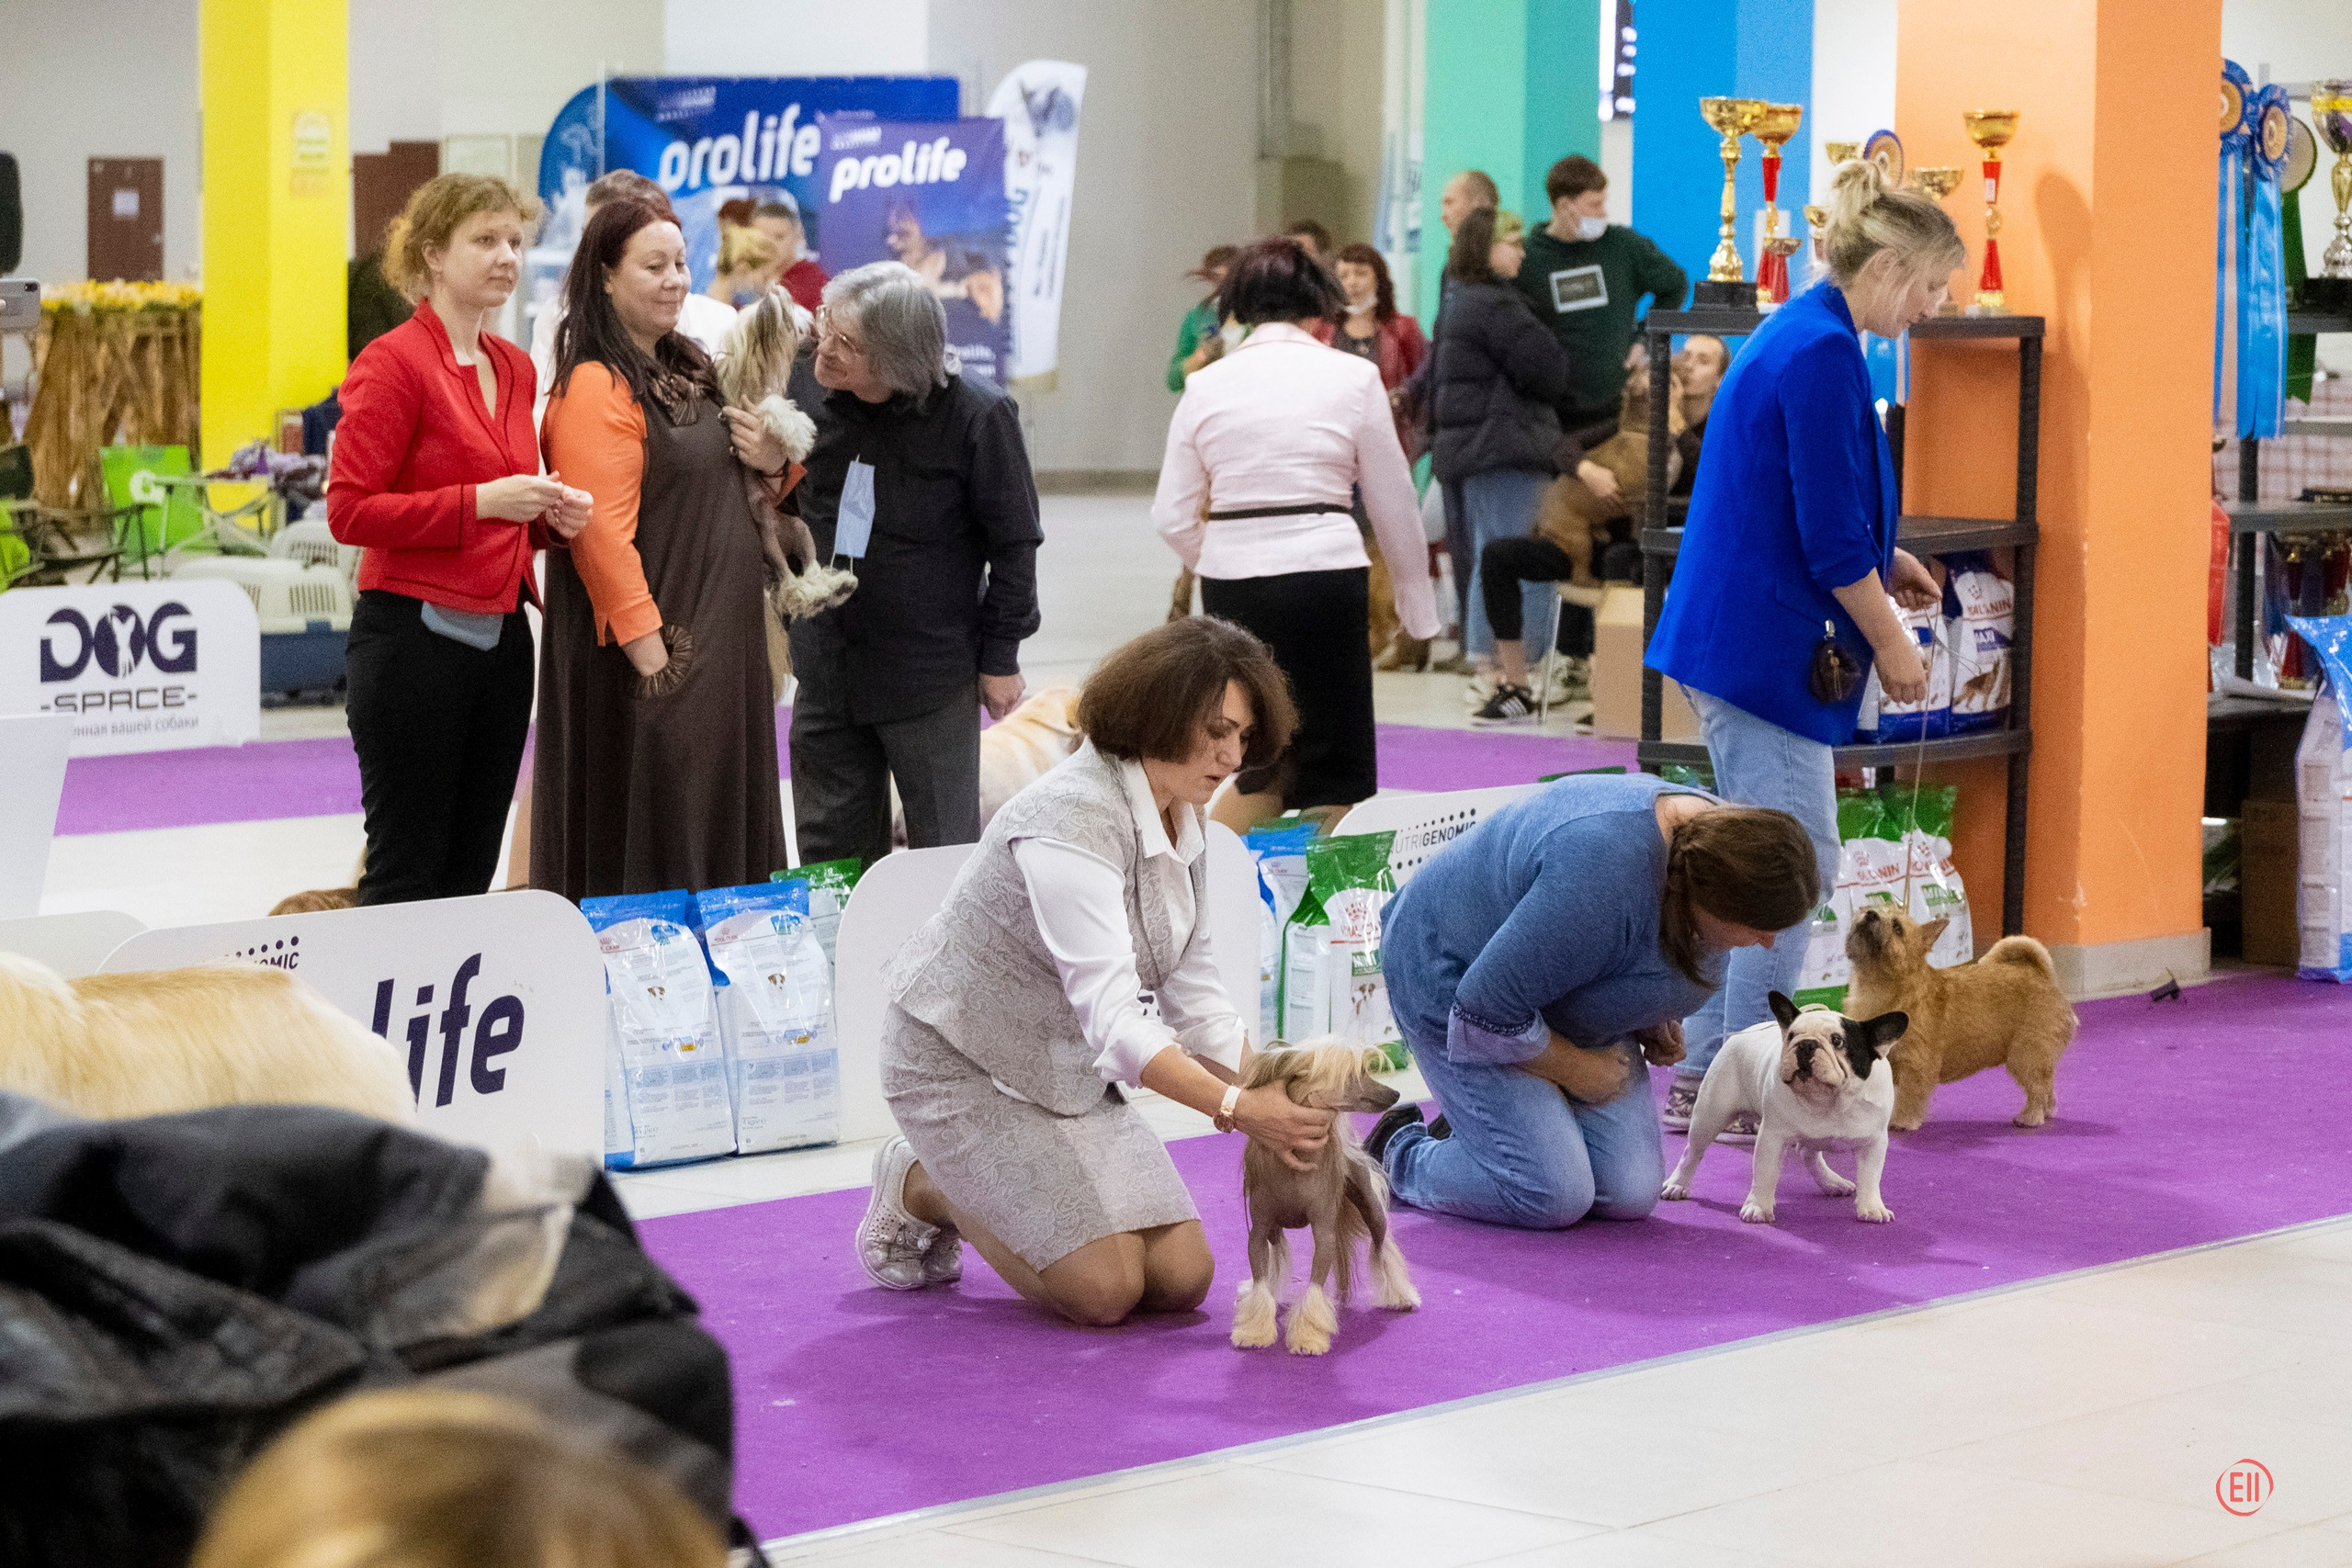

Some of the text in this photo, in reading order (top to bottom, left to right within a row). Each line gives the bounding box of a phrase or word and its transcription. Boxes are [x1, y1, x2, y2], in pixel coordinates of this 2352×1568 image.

[829, 136, 967, 203] prolife
[40, 601, 198, 682] DOG
[154, 716, 199, 733] собаки
